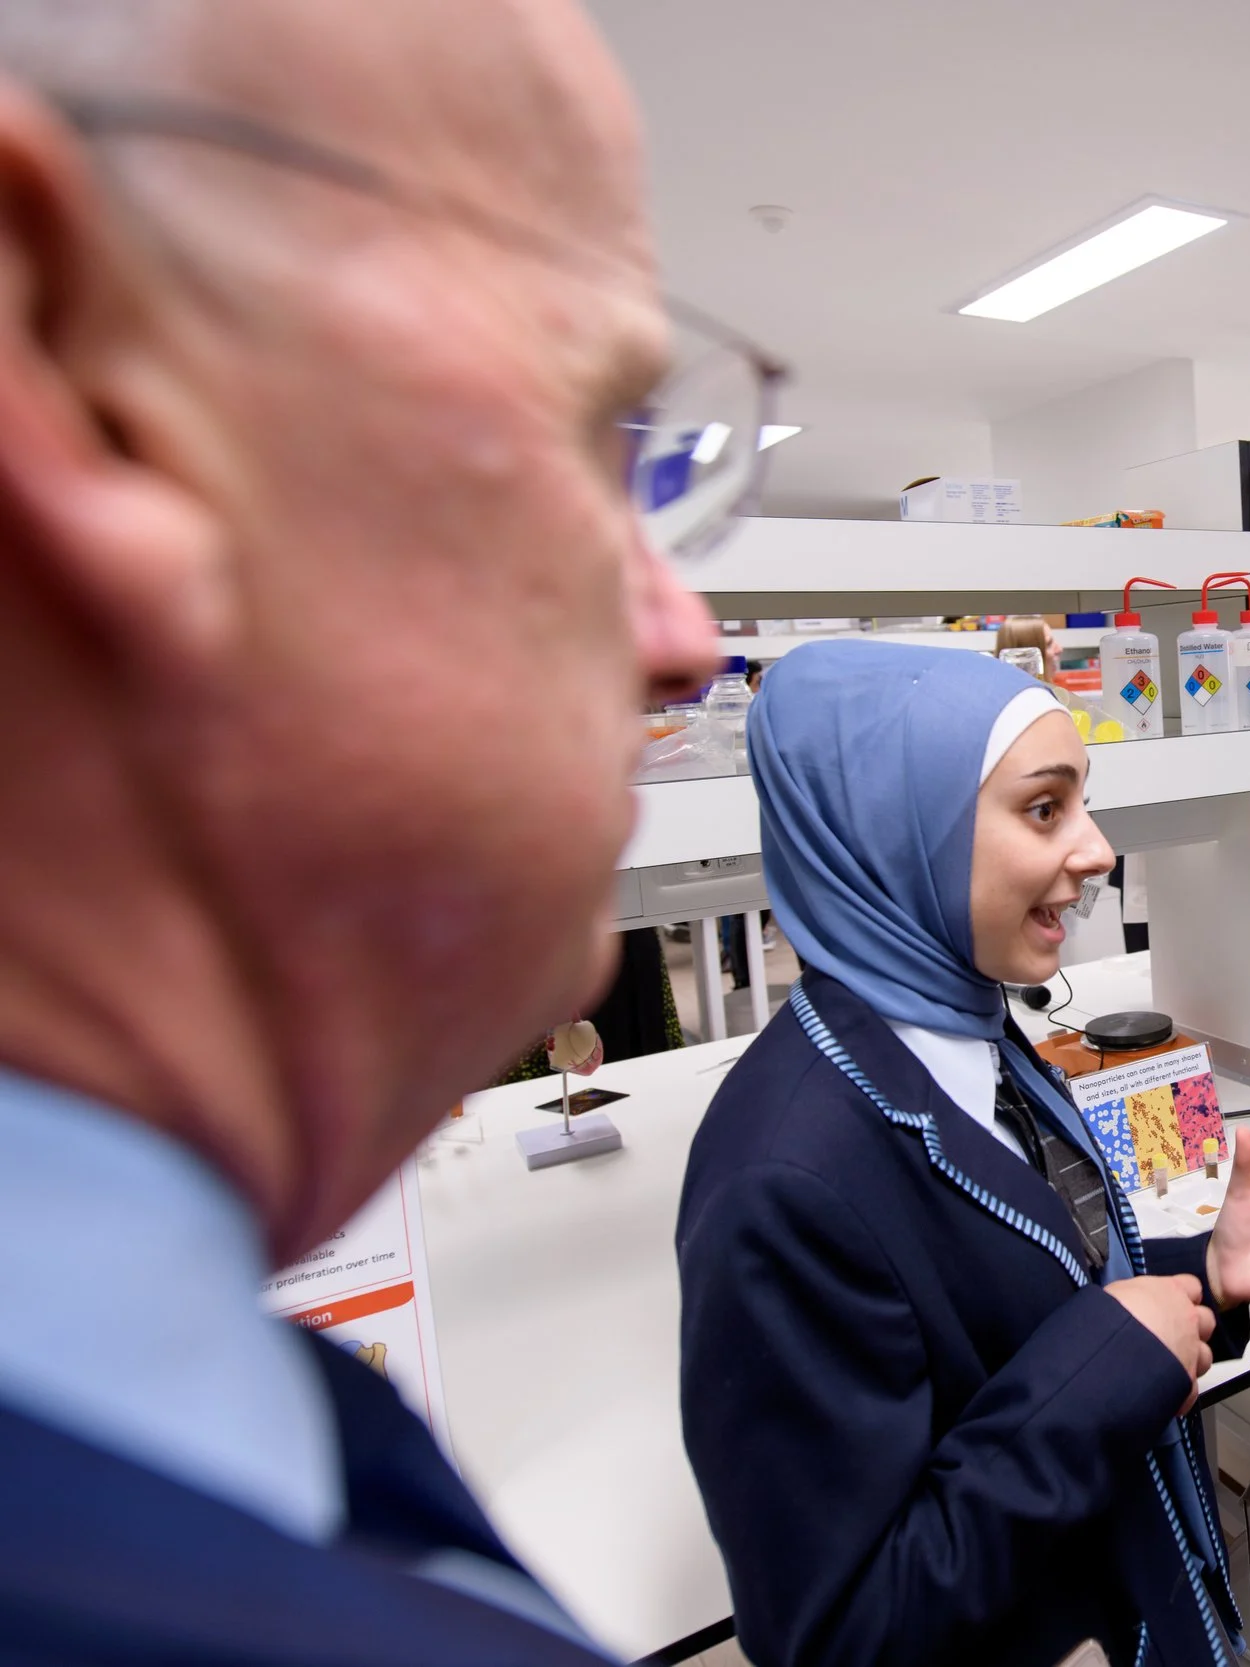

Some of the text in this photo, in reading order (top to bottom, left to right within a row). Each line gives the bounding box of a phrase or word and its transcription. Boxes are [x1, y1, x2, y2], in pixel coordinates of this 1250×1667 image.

[1137, 675, 1146, 687] 3
[1197, 670, 1205, 680] 0
[1188, 680, 1216, 691] 0 0
[1126, 686, 1155, 699] 2 0
[1078, 1073, 1125, 1091] Nanoparticles
[1126, 1070, 1138, 1078] can
[1139, 1065, 1155, 1075] come
[1163, 1058, 1180, 1068] many
[1181, 1052, 1202, 1063] shapes
[1086, 1064, 1200, 1102] and sizes, all with different functions!
[276, 1264, 343, 1290] proliferation
[345, 1258, 369, 1270] over
[371, 1250, 396, 1263] time
